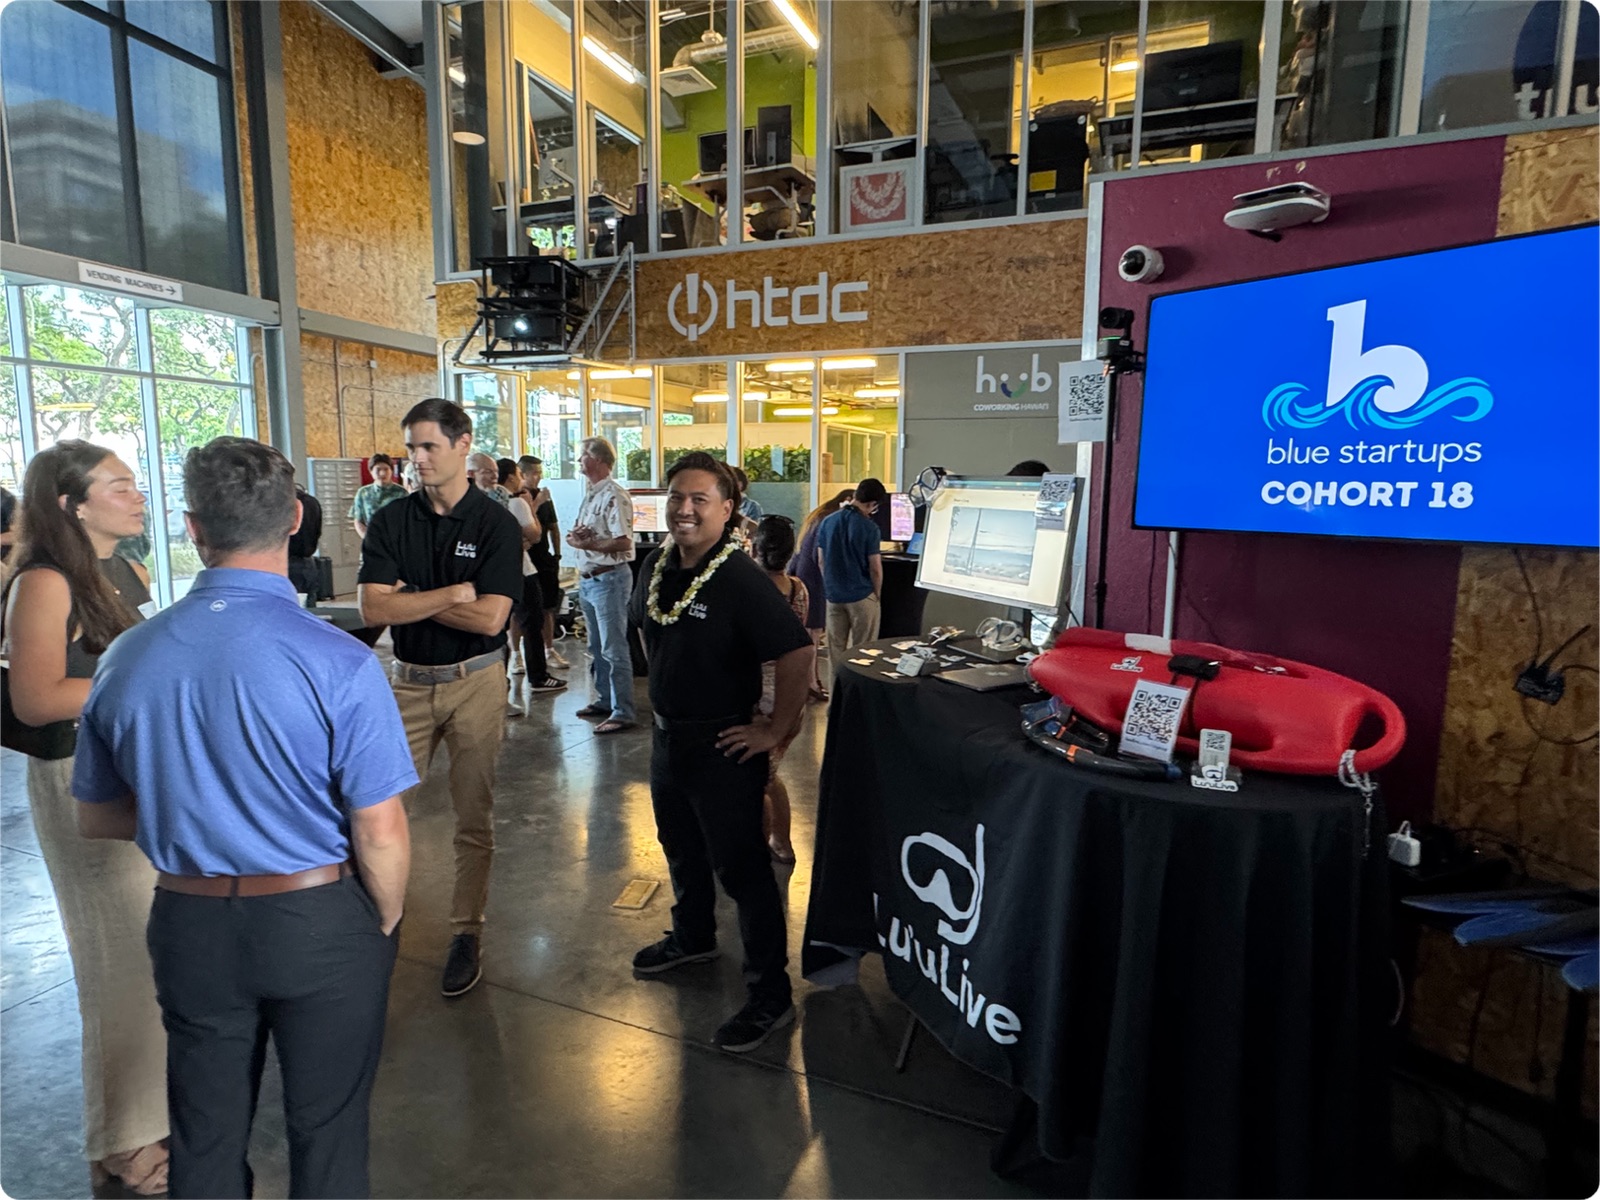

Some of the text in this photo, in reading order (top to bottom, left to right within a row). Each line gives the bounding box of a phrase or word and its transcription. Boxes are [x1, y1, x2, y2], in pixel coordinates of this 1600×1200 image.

[86, 269, 164, 292] VENDING MACHINES
[726, 271, 869, 329] htdc
[973, 403, 1020, 411] COWORKING
[1266, 437, 1483, 473] blue startups
[1261, 480, 1474, 509] COHORT 18
